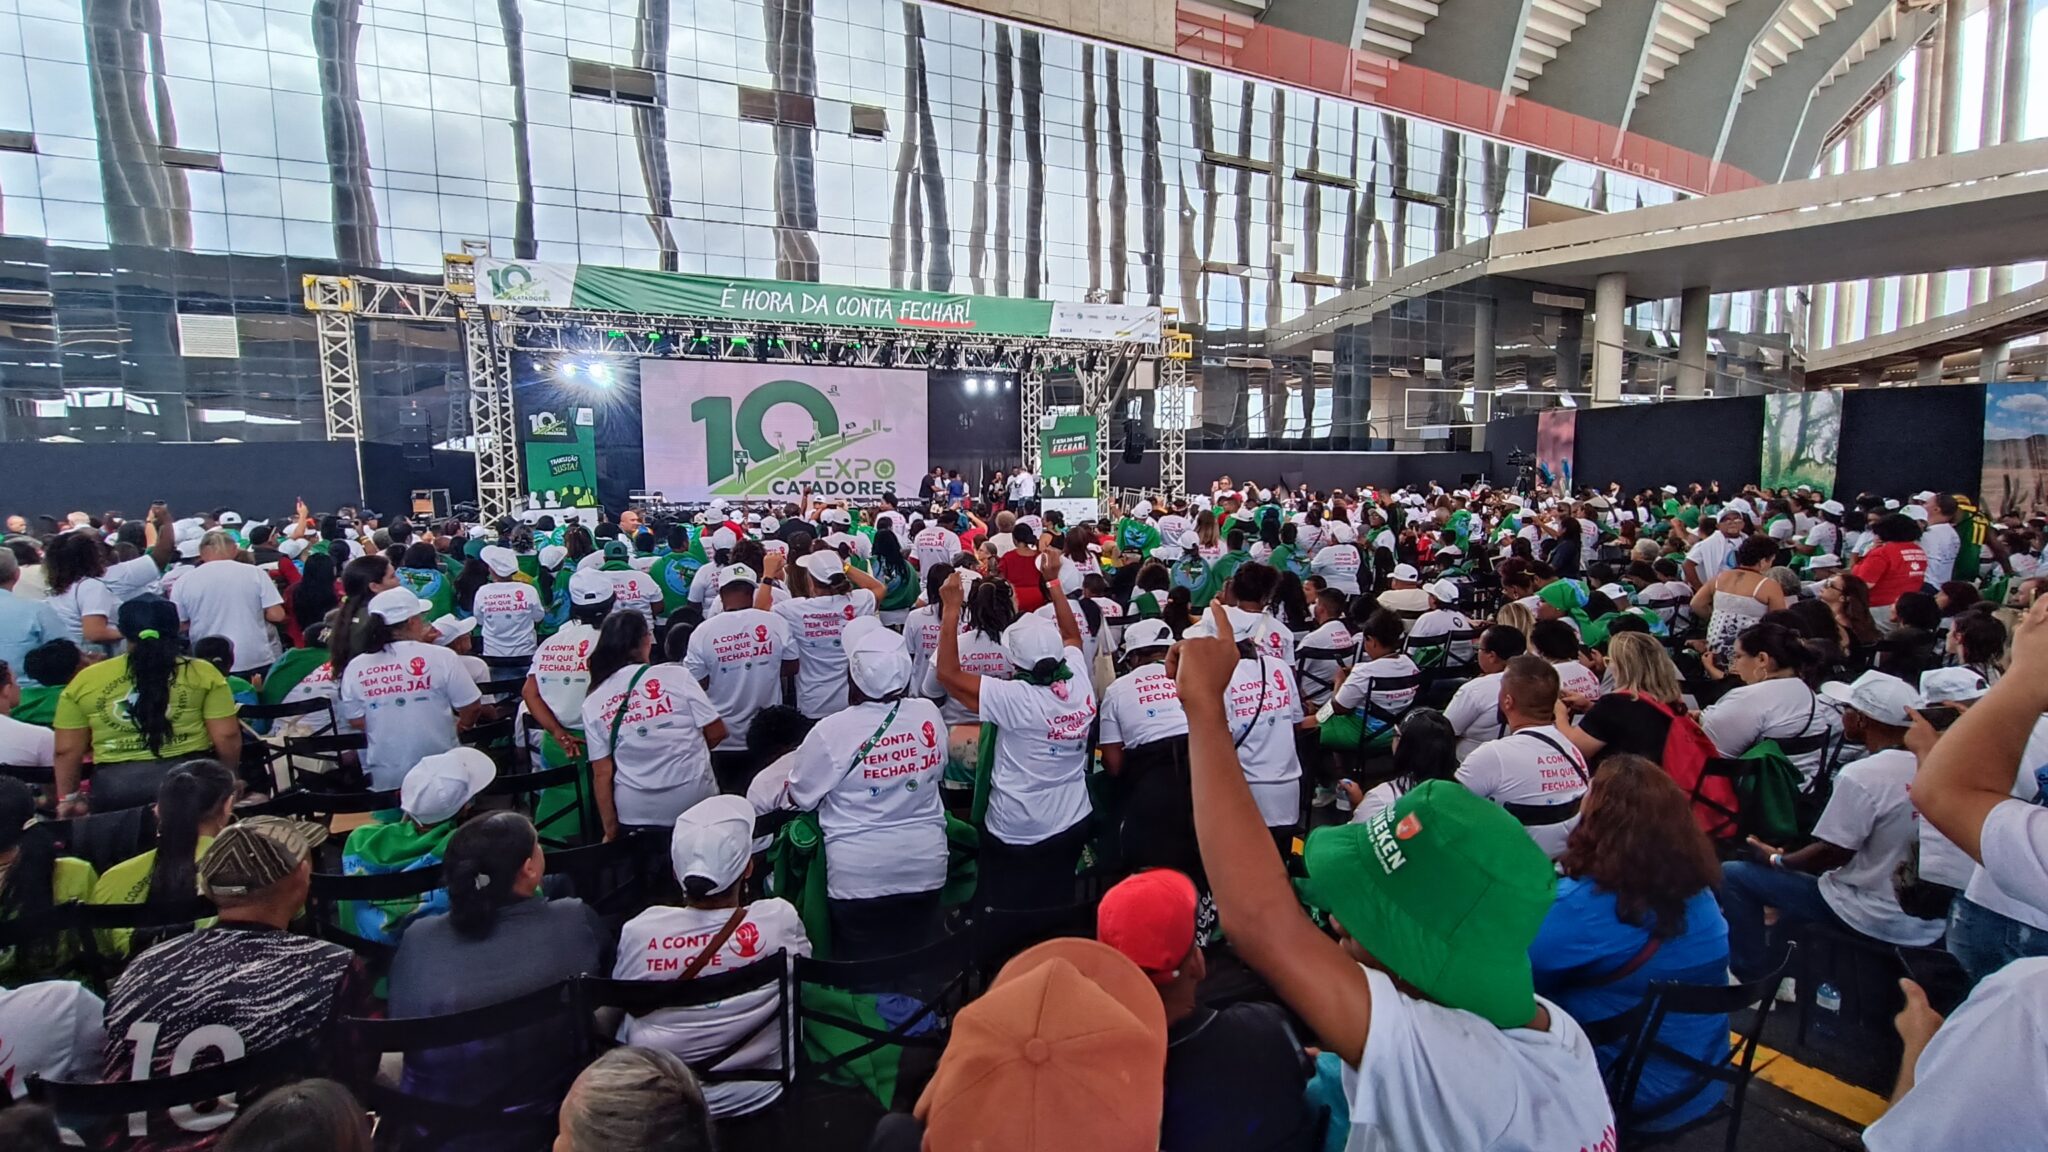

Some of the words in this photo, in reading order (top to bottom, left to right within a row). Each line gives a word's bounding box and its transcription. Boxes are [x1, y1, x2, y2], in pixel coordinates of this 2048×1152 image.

[486, 264, 532, 297] 10
[720, 282, 737, 309] É
[742, 288, 794, 314] HORA
[801, 293, 829, 316] DA
[836, 296, 893, 319] CONTA
[899, 299, 970, 324] FECHAR!
[691, 379, 839, 487] 10
[815, 458, 896, 479] EXPO
[771, 480, 897, 495] CATADORES
[513, 601, 528, 611] JÁ!
[822, 620, 840, 628] QUE
[720, 632, 750, 643] CONTA
[551, 644, 575, 652] CONTA
[715, 645, 733, 655] TEM
[734, 641, 751, 651] QUE
[753, 640, 773, 657] JÁ!
[557, 653, 574, 662] QUE
[970, 652, 1003, 660] CONTA
[366, 663, 402, 675] CONTA
[960, 664, 980, 672] TEM
[381, 674, 404, 685] QUE
[407, 675, 432, 692] JÁ!
[1136, 684, 1160, 693] TEM
[646, 695, 673, 719] JÁ!
[1232, 696, 1254, 706] TEM
[873, 732, 916, 748] CONTA
[863, 753, 888, 765] TEM
[891, 747, 918, 761] QUE
[864, 762, 919, 779] FECHAR,
[920, 748, 942, 771] JÁ!
[1540, 769, 1559, 778] TEM
[1560, 767, 1576, 777] QUE
[1542, 780, 1579, 792] FECHAR,
[648, 938, 657, 950] A
[646, 958, 678, 972] TEM
